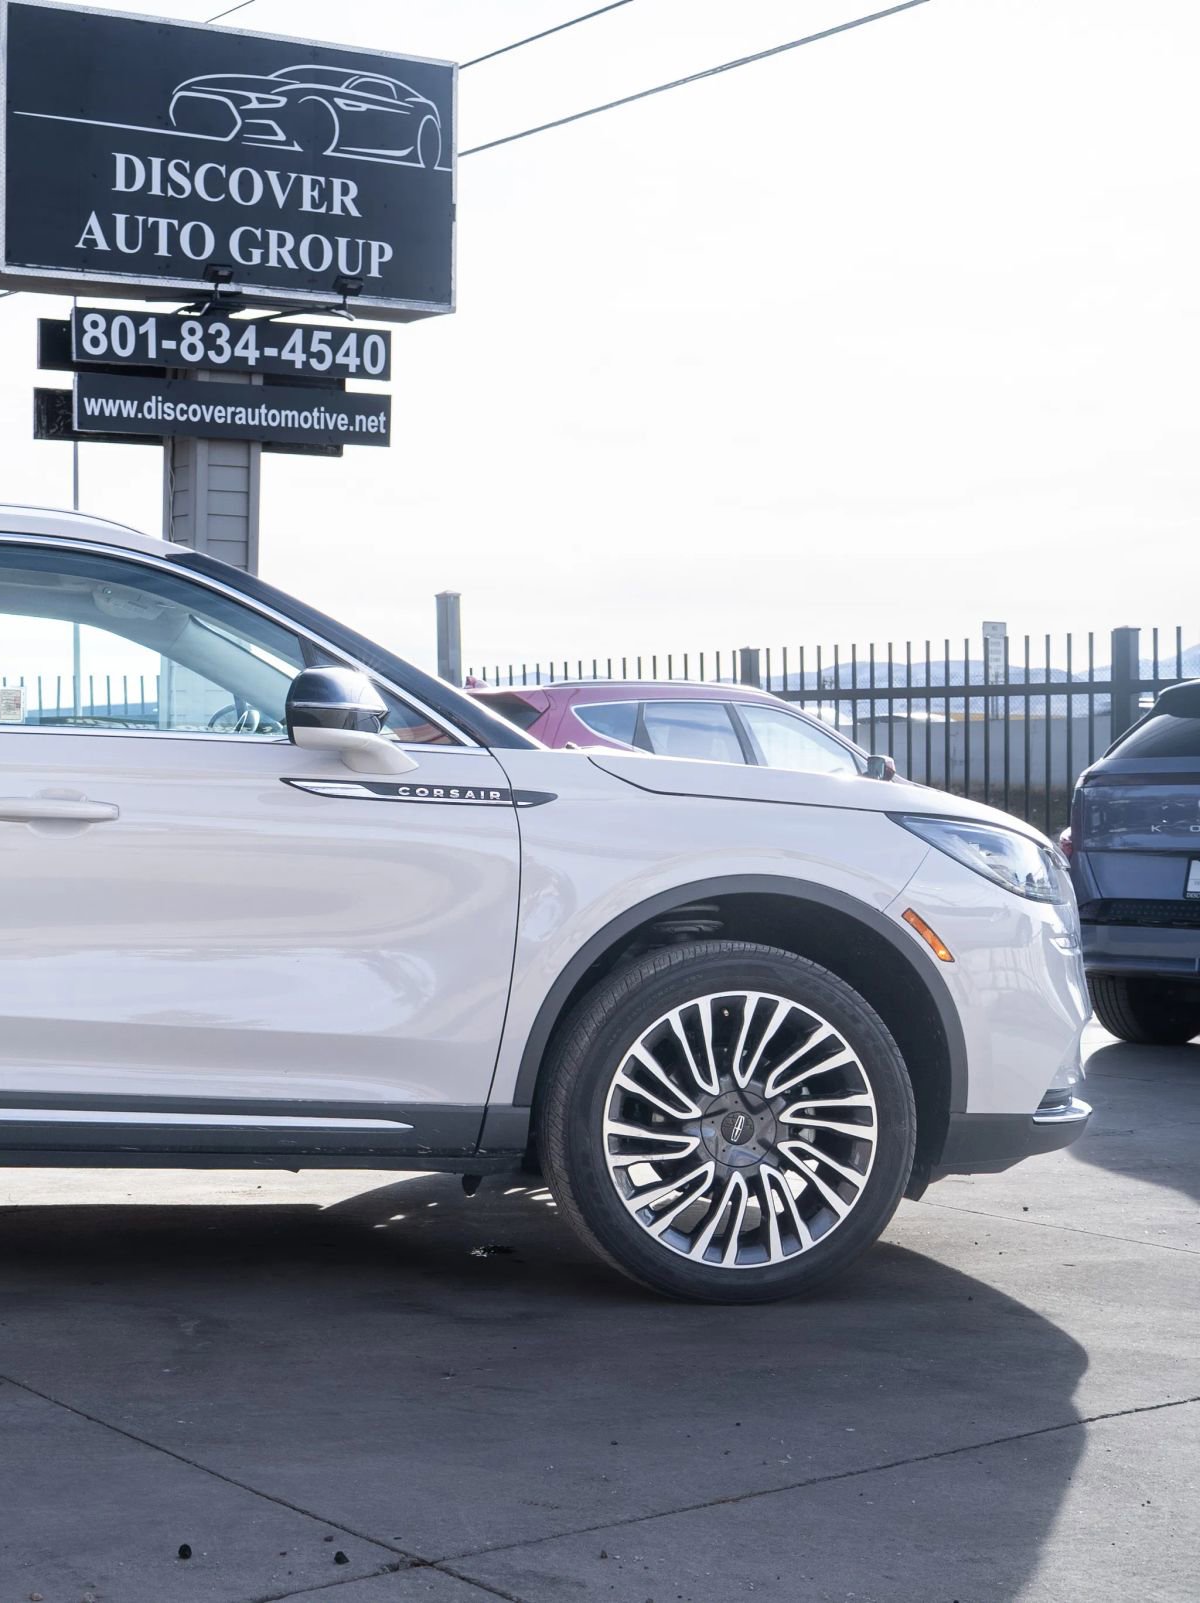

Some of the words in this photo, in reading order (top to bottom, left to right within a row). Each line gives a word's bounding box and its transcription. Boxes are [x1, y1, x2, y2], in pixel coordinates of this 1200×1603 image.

[111, 153, 362, 218] DISCOVER
[75, 211, 215, 261] AUTO
[229, 226, 393, 278] GROUP
[82, 313, 386, 375] 801-834-4540
[83, 395, 387, 434] www.discoverautomotive.net
[398, 786, 501, 800] CORSAIR
